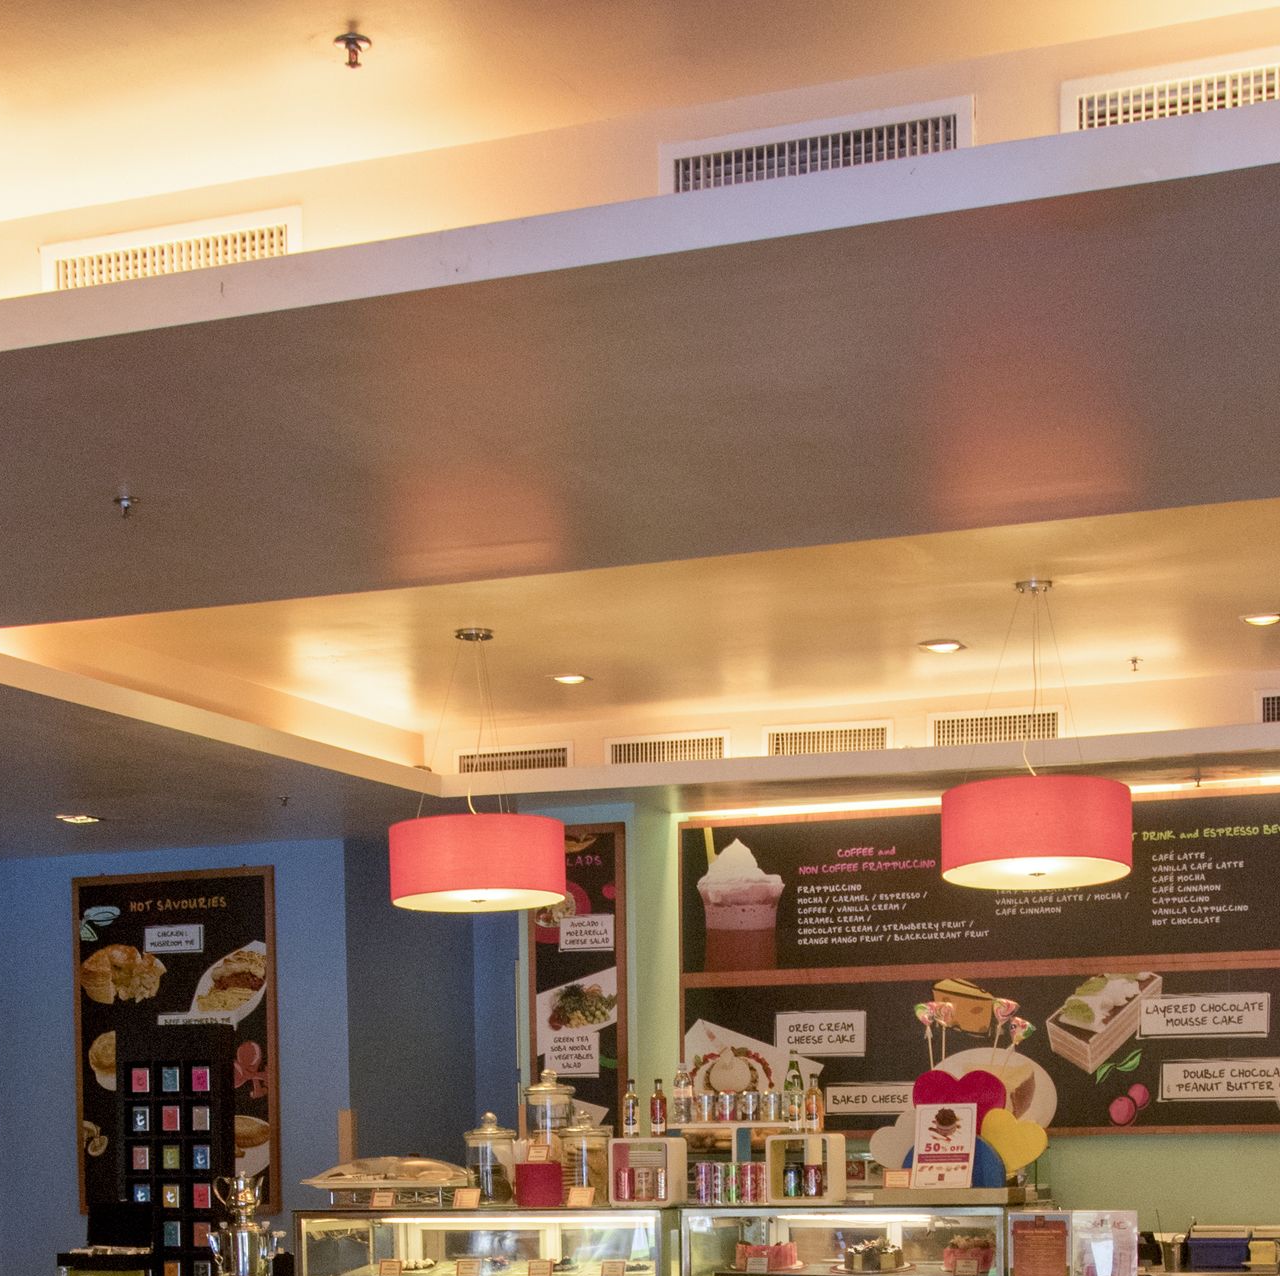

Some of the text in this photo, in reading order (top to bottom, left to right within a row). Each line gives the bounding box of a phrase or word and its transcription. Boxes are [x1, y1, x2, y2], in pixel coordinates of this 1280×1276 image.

[1142, 831, 1175, 841] DRINK
[1180, 829, 1199, 839] and
[1203, 826, 1259, 838] ESPRESSO
[837, 846, 896, 858] COFFEE and
[1152, 851, 1205, 862] CAFÉ LATTE
[799, 860, 936, 874] NON COFFEE FRAPPUCCINO
[1152, 860, 1244, 872] VANILLA CAFÉ LATTE
[1152, 872, 1205, 883] CAFÉ MOCHA
[798, 884, 862, 894] FRAPPUCCINO
[1152, 884, 1221, 894] CAFÉ CINNAMON
[798, 892, 920, 904] MOCHA CARAMEL ESPRESSO
[996, 896, 1030, 905] VANILLA
[1032, 892, 1054, 904] CAFÉ
[1056, 894, 1083, 902] LATTE
[1152, 896, 1210, 905] CAPPUCCINO
[130, 896, 227, 912] HOT SAVOURIES
[798, 903, 900, 914] COFFEE VANILLA CREAM
[995, 905, 1061, 916] CAFÉ CINNAMON
[1152, 905, 1248, 915] VANILLA CAPPUCCINO
[798, 917, 834, 925] CARAMEL
[1171, 916, 1220, 925] CHOCOLATE
[798, 926, 842, 935] CHOCOLATE
[845, 925, 873, 933] CREAM
[882, 922, 939, 932] STRAWBERRY
[797, 929, 990, 945] ORANGE MANGO FRUIT BLACKCURRANT FRUIT
[1145, 1001, 1264, 1018] LAYERED CHOCOLATE
[1166, 1015, 1244, 1027] MOUSSE CAKE
[788, 1022, 854, 1033] OREO CREAM
[787, 1034, 856, 1044] CHEESE CAKE
[1183, 1069, 1225, 1079] DOUBLE
[1176, 1082, 1222, 1093] PEANUT
[1227, 1081, 1274, 1091] BUTTER
[832, 1094, 909, 1105] BAKED CHEESE
